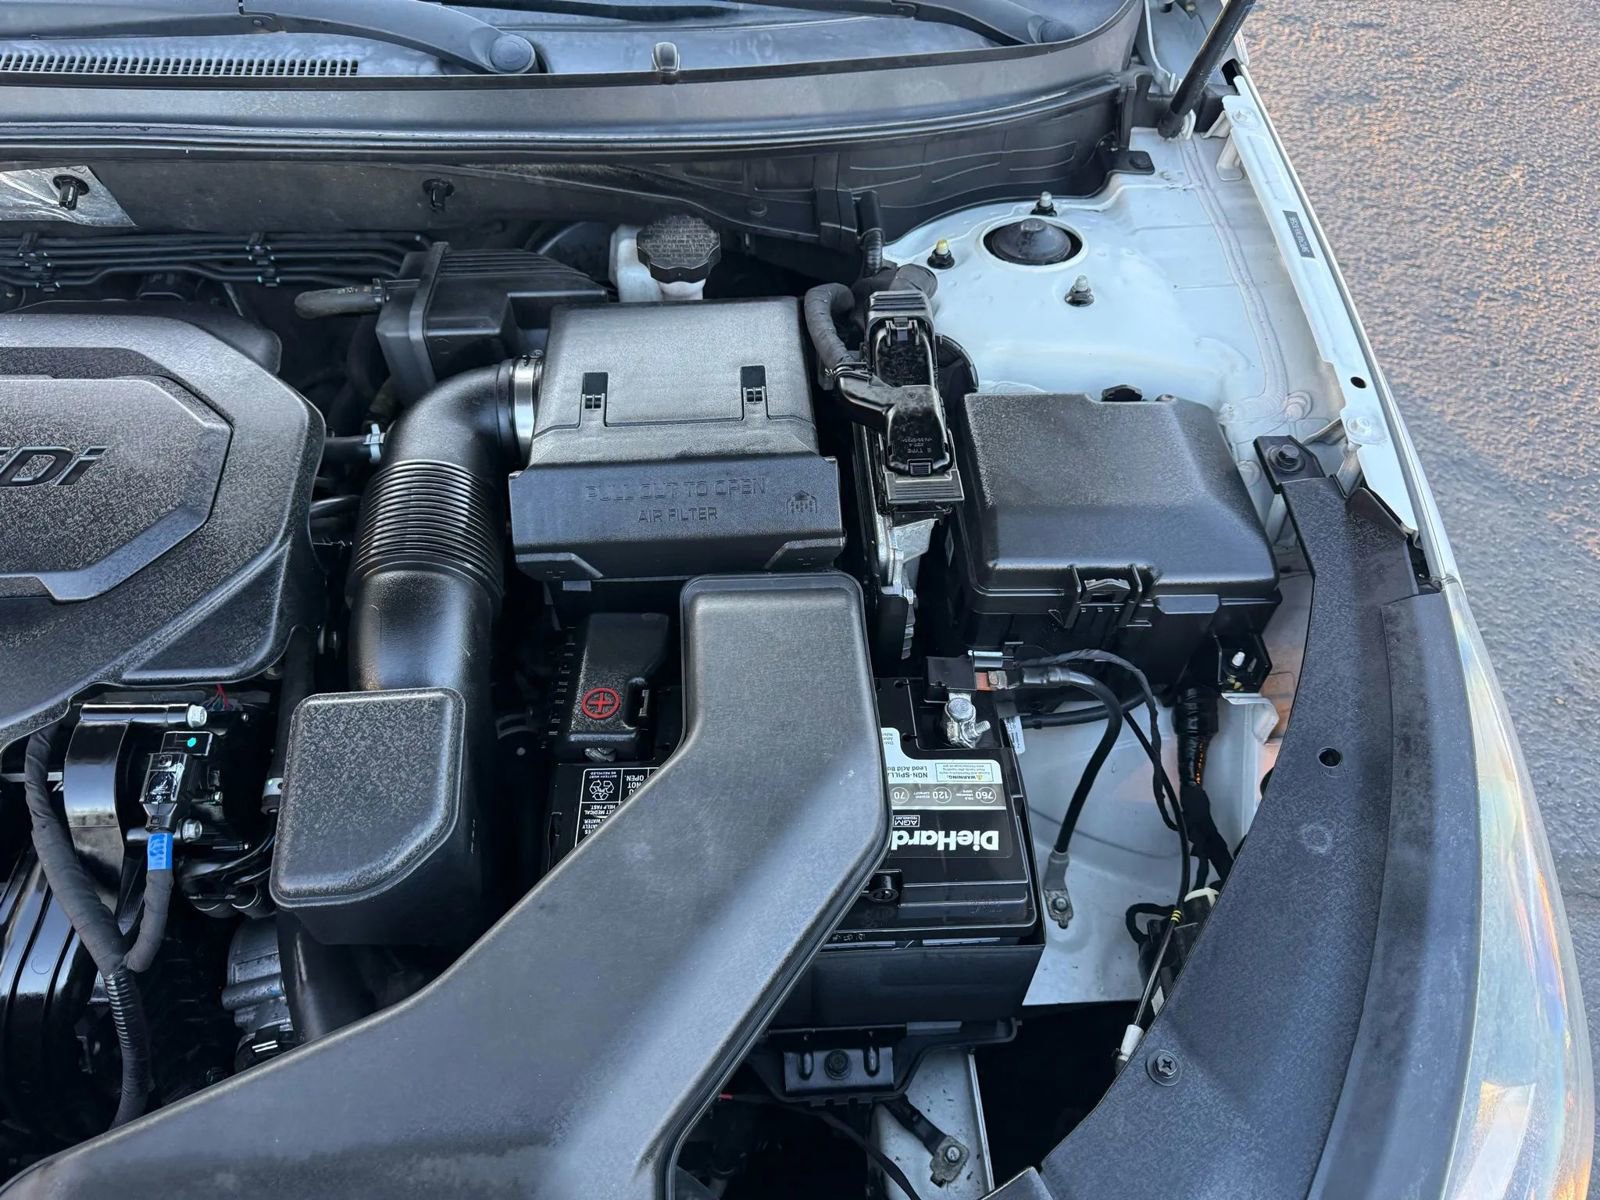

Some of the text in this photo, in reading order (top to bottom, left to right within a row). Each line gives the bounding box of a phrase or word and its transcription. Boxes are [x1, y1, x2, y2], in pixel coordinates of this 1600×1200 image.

[0, 445, 107, 487] Di
[639, 482, 677, 499] OUT
[683, 481, 708, 497] TO
[715, 477, 766, 496] OPEN
[638, 507, 718, 523] AIR FILTER
[893, 791, 905, 799] 70
[932, 791, 949, 800] 120
[975, 791, 993, 800] 760
[891, 830, 999, 851] DieHard
